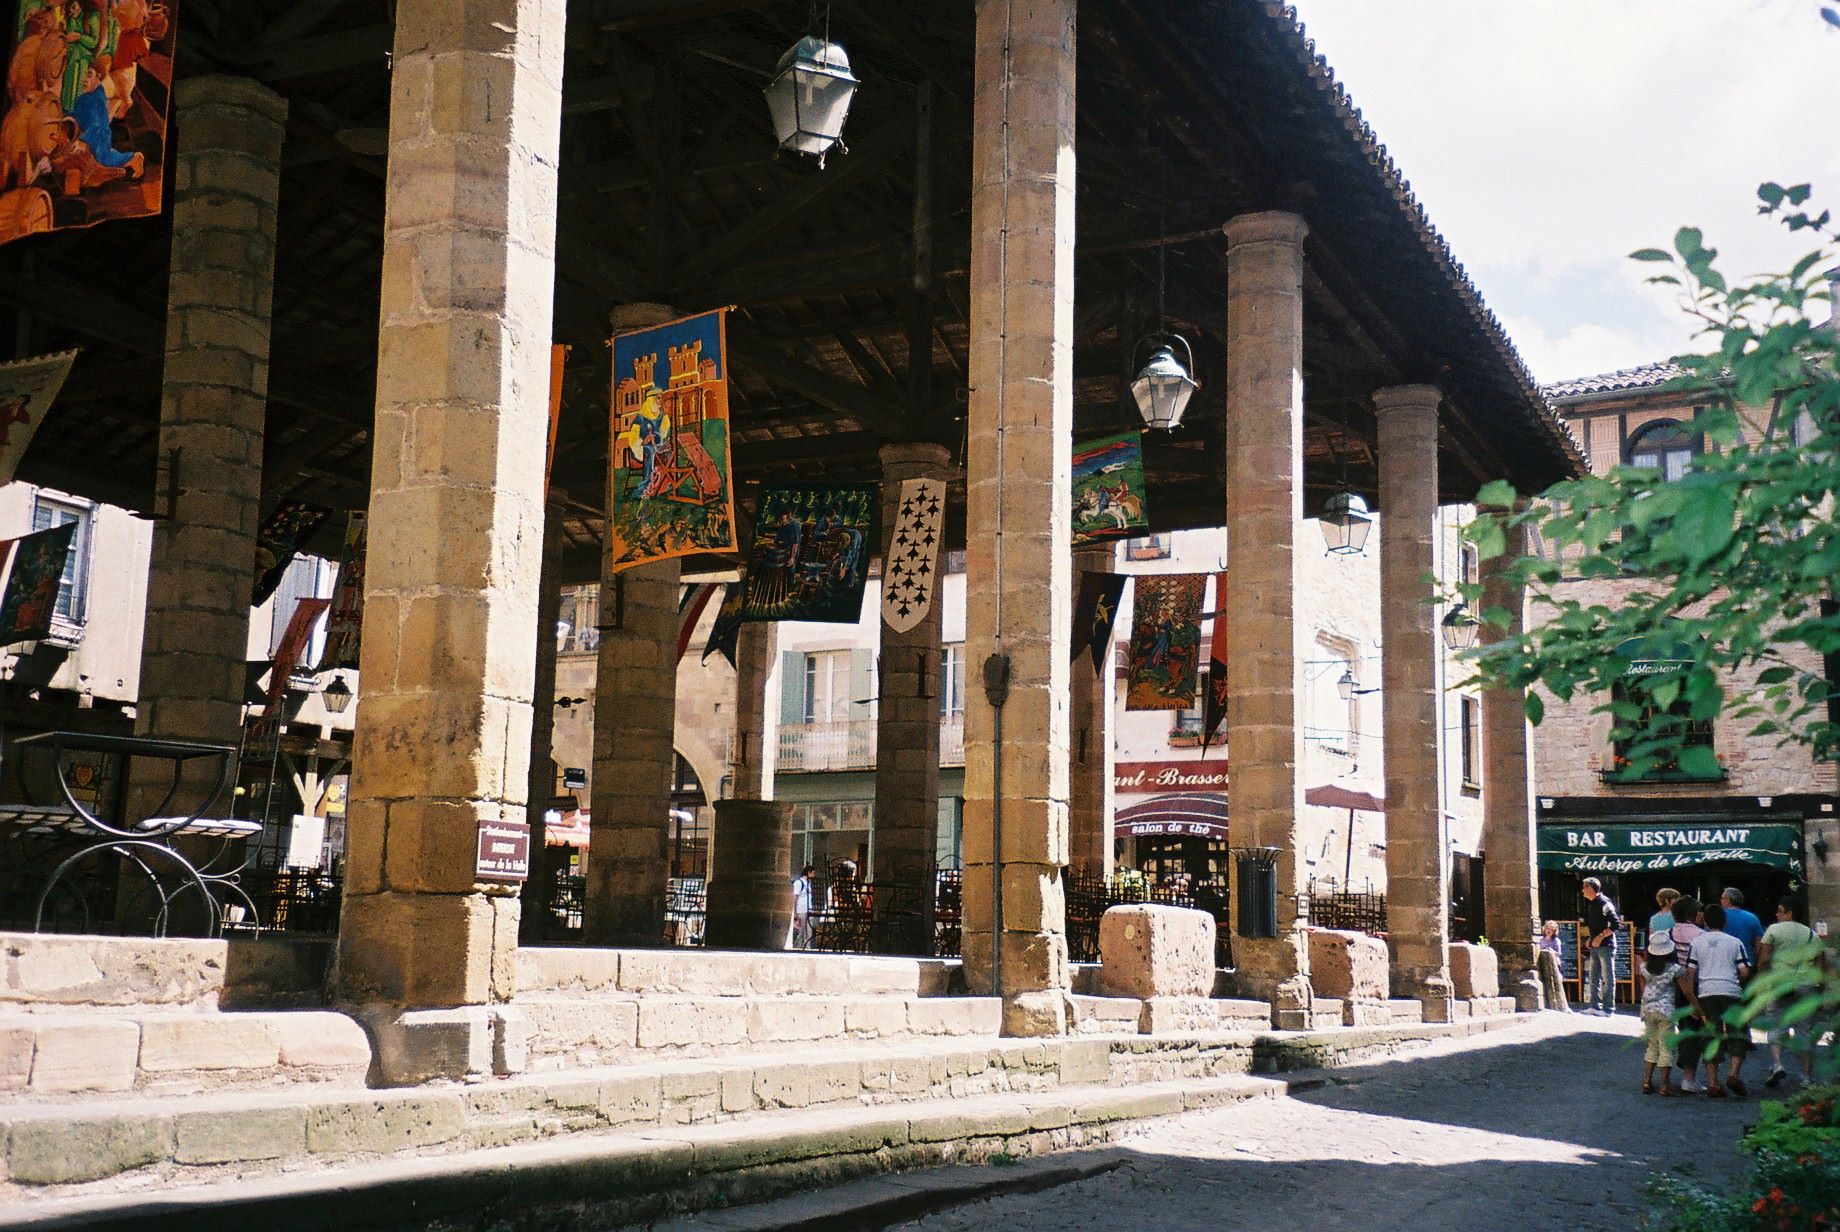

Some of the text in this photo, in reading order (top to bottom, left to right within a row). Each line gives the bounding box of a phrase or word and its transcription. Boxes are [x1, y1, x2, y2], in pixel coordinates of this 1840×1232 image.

[1131, 823, 1163, 834] salon
[1167, 822, 1182, 832] de
[1567, 829, 1750, 847] BAR RESTAURANT
[1565, 855, 1644, 873] Auberge
[1647, 855, 1670, 869] de
[1673, 853, 1691, 867] la
